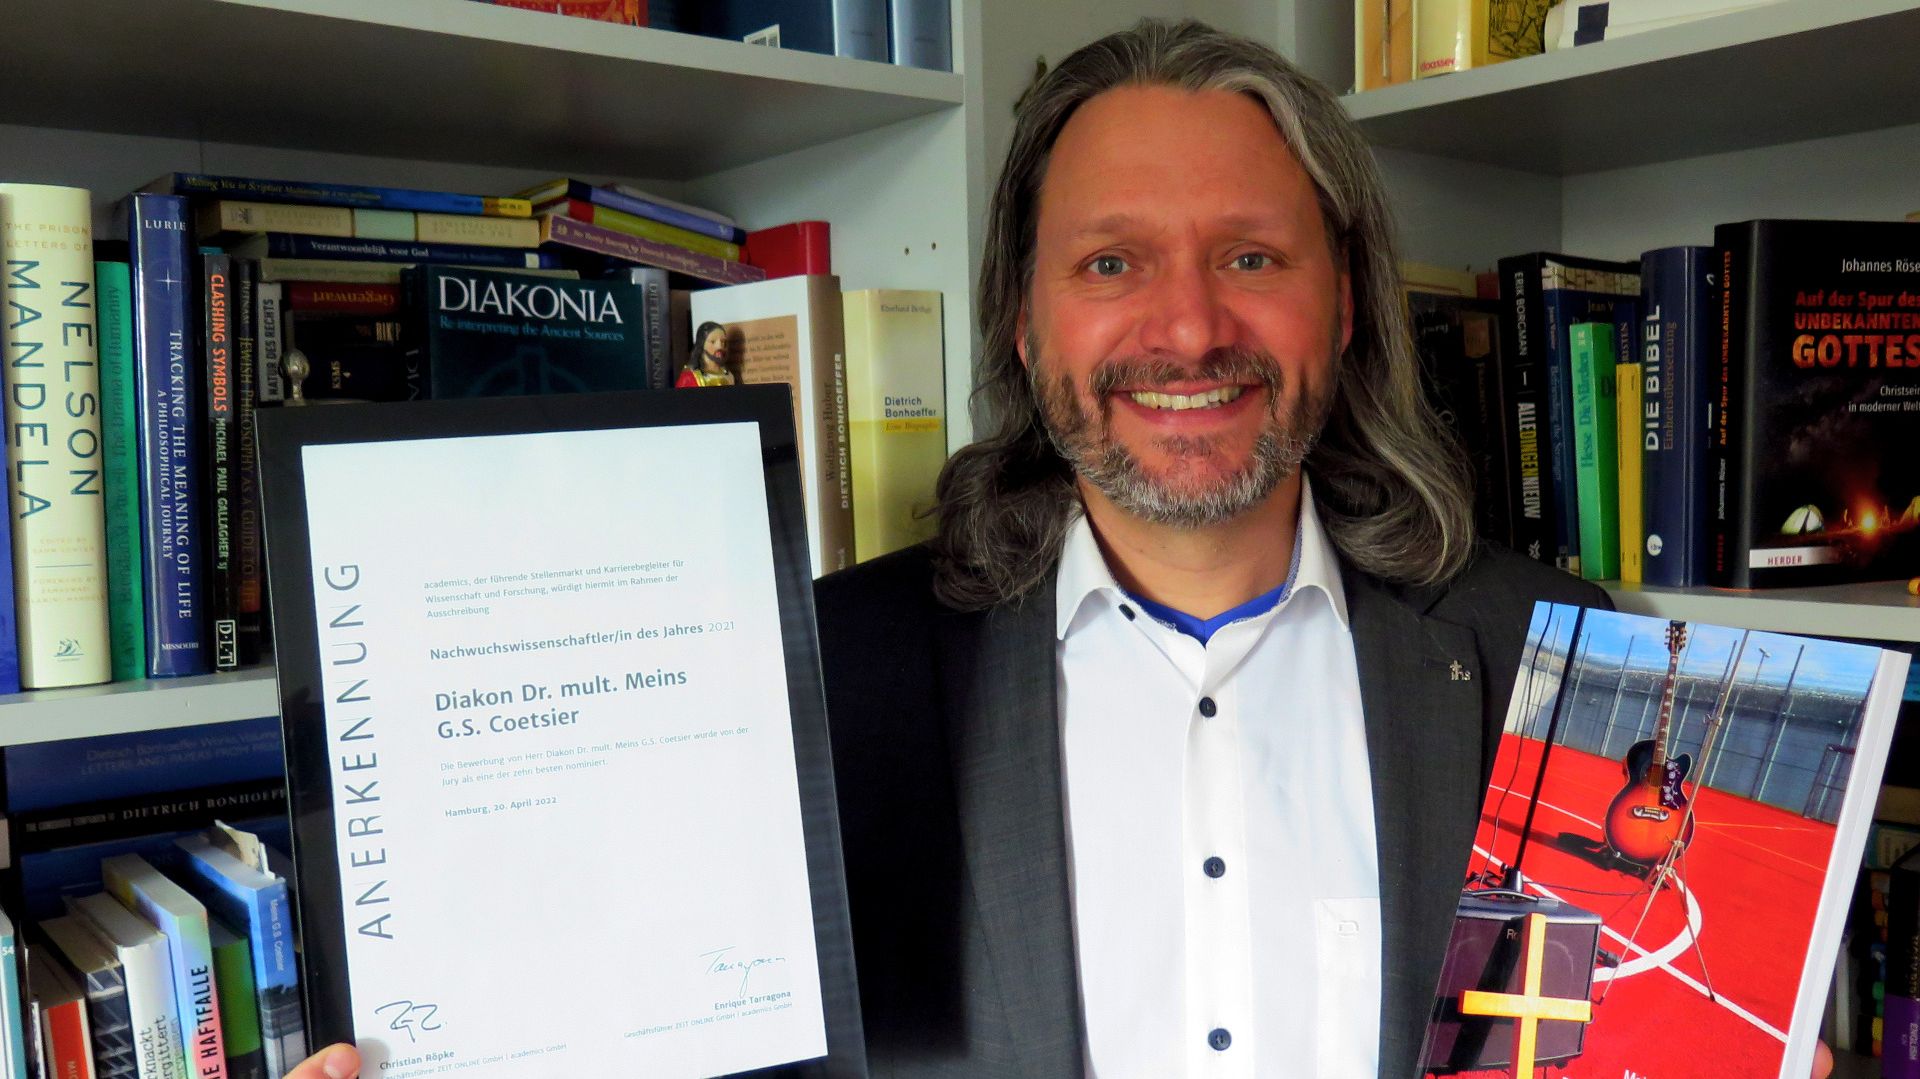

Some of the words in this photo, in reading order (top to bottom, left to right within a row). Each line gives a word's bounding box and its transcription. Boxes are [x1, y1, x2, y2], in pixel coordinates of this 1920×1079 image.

[38, 223, 89, 235] PRISON
[144, 219, 188, 232] LURIE
[6, 239, 67, 250] LETTERS
[1841, 258, 1892, 273] Johannes
[1895, 258, 1920, 273] Röse
[211, 273, 226, 343] CLASHING
[438, 275, 624, 325] DIAKONIA
[1795, 290, 1825, 308] Auf
[1827, 290, 1853, 307] der
[1858, 290, 1894, 310] Spur
[521, 323, 541, 337] the
[542, 324, 582, 339] Ancient
[583, 328, 625, 342] Sources
[1794, 312, 1920, 331] UNBEKANNTEN
[1646, 305, 1661, 394] BIBEL
[1792, 334, 1920, 368] GOTTES
[6, 260, 52, 519] MANDELA
[60, 280, 100, 496] NELSON
[170, 330, 185, 415] TRACKING
[213, 349, 228, 412] SYMBOLS
[835, 353, 845, 443] BONHOEFFER
[884, 396, 922, 407] Dietrich
[885, 407, 937, 418] Bonhoeffer
[1848, 401, 1857, 413] in
[1859, 401, 1901, 413] moderner
[172, 417, 187, 458] THE
[214, 417, 228, 464] MICHAEL
[1646, 402, 1660, 451] DIE
[158, 402, 171, 500] PHILOSOPHICAL
[215, 467, 228, 493] PAUL
[840, 447, 849, 509] DIETRICH
[174, 464, 190, 548] MEANING
[161, 504, 174, 560] JOURNEY
[216, 497, 230, 559] GALLAGHER
[177, 552, 190, 575] OF
[424, 579, 471, 590] academics,
[473, 576, 487, 586] der
[490, 573, 528, 584] führende
[530, 569, 583, 581] Stellenmarkt
[585, 565, 601, 576] und
[604, 561, 670, 574] Karrierebegleiter
[672, 560, 684, 568] für
[1767, 555, 1803, 566] HERDER
[178, 581, 193, 620] LIFE
[425, 592, 482, 604] Wissenschaft
[484, 590, 500, 599] und
[503, 586, 549, 598] Forschung,
[551, 582, 582, 594] würdigt
[585, 580, 615, 590] hiermit
[617, 579, 628, 587] im
[630, 576, 663, 586] Rahmen
[665, 574, 678, 583] der
[426, 605, 490, 619] Ausschreibung
[161, 642, 200, 651] MISSOURI
[430, 630, 632, 661] Nachwuchswissenschaftler/in
[636, 625, 659, 641] des
[663, 622, 704, 638] Jahres
[707, 620, 735, 633] 2021
[435, 685, 514, 712] Diakon
[522, 682, 553, 703] Dr.
[560, 675, 618, 699] mult.
[625, 668, 687, 691] Meins
[437, 717, 482, 739] G.S.
[489, 707, 580, 734] Coetsier
[324, 564, 394, 940] ANERKENNUNG
[440, 763, 455, 772] Die
[457, 757, 505, 770] Bewerbung
[507, 755, 523, 763] von
[525, 753, 543, 761] Herr
[546, 749, 574, 759] Diakon
[576, 746, 589, 755] Dr.
[591, 744, 612, 753] mult.
[615, 740, 639, 750] Meins
[641, 737, 657, 747] G.S.
[659, 734, 692, 744] Coetsier
[693, 730, 718, 740] wurde
[719, 729, 734, 737] von
[736, 726, 749, 735] der
[442, 777, 459, 788] Jury
[462, 775, 474, 784] als
[476, 773, 494, 782] eine
[496, 771, 510, 780] der
[513, 768, 533, 777] zehn
[535, 764, 563, 774] besten
[565, 757, 608, 770] nominiert.
[122, 800, 200, 820] DIETRICH
[206, 787, 287, 809] BONHOEFF
[445, 805, 491, 818] Hamburg,
[494, 803, 508, 812] 20.
[510, 799, 532, 810] April
[535, 796, 557, 806] 2022
[190, 965, 218, 1059] HAFTFALLE
[714, 997, 747, 1012] Enrique
[749, 990, 792, 1006] Tarragona
[623, 1023, 673, 1039] Geschäftsführer
[675, 1020, 690, 1030] ZEIT
[691, 1016, 715, 1027] ONLINE
[716, 1012, 736, 1022] GmbH
[742, 1006, 773, 1018] academics
[773, 1001, 793, 1012] GmbH
[153, 1014, 176, 1079] ergittert
[380, 1055, 423, 1071] Christian
[425, 1050, 456, 1063] Röpke
[437, 1062, 453, 1073] ZEIT
[454, 1058, 480, 1070] ONLINE
[482, 1055, 504, 1065] GmbH
[511, 1049, 545, 1060] academics
[546, 1043, 568, 1053] GmbH
